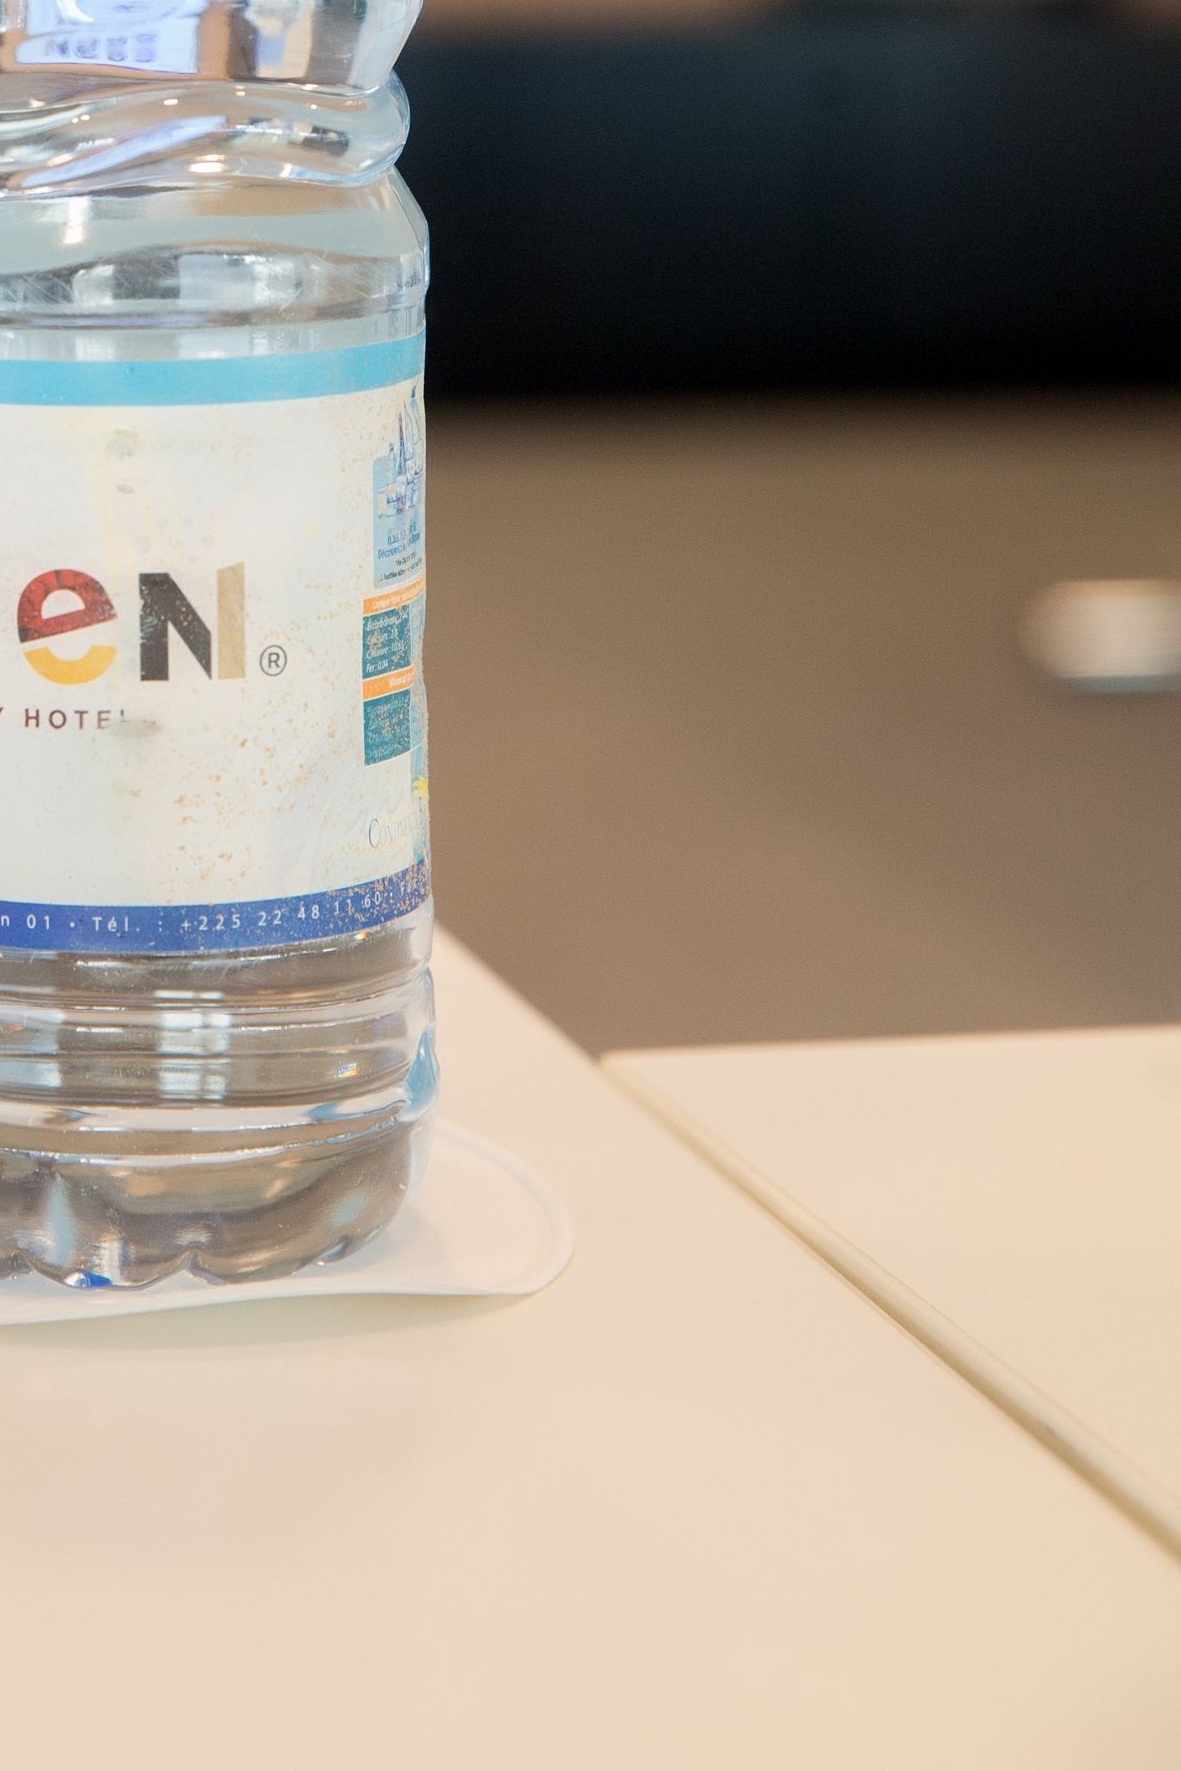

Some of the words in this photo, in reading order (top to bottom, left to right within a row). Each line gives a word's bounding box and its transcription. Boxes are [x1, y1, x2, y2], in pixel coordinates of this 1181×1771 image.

[26, 915, 52, 931] 01
[180, 912, 241, 931] +225
[257, 910, 283, 928] 22
[296, 904, 320, 923] 48
[364, 889, 382, 909] 60
